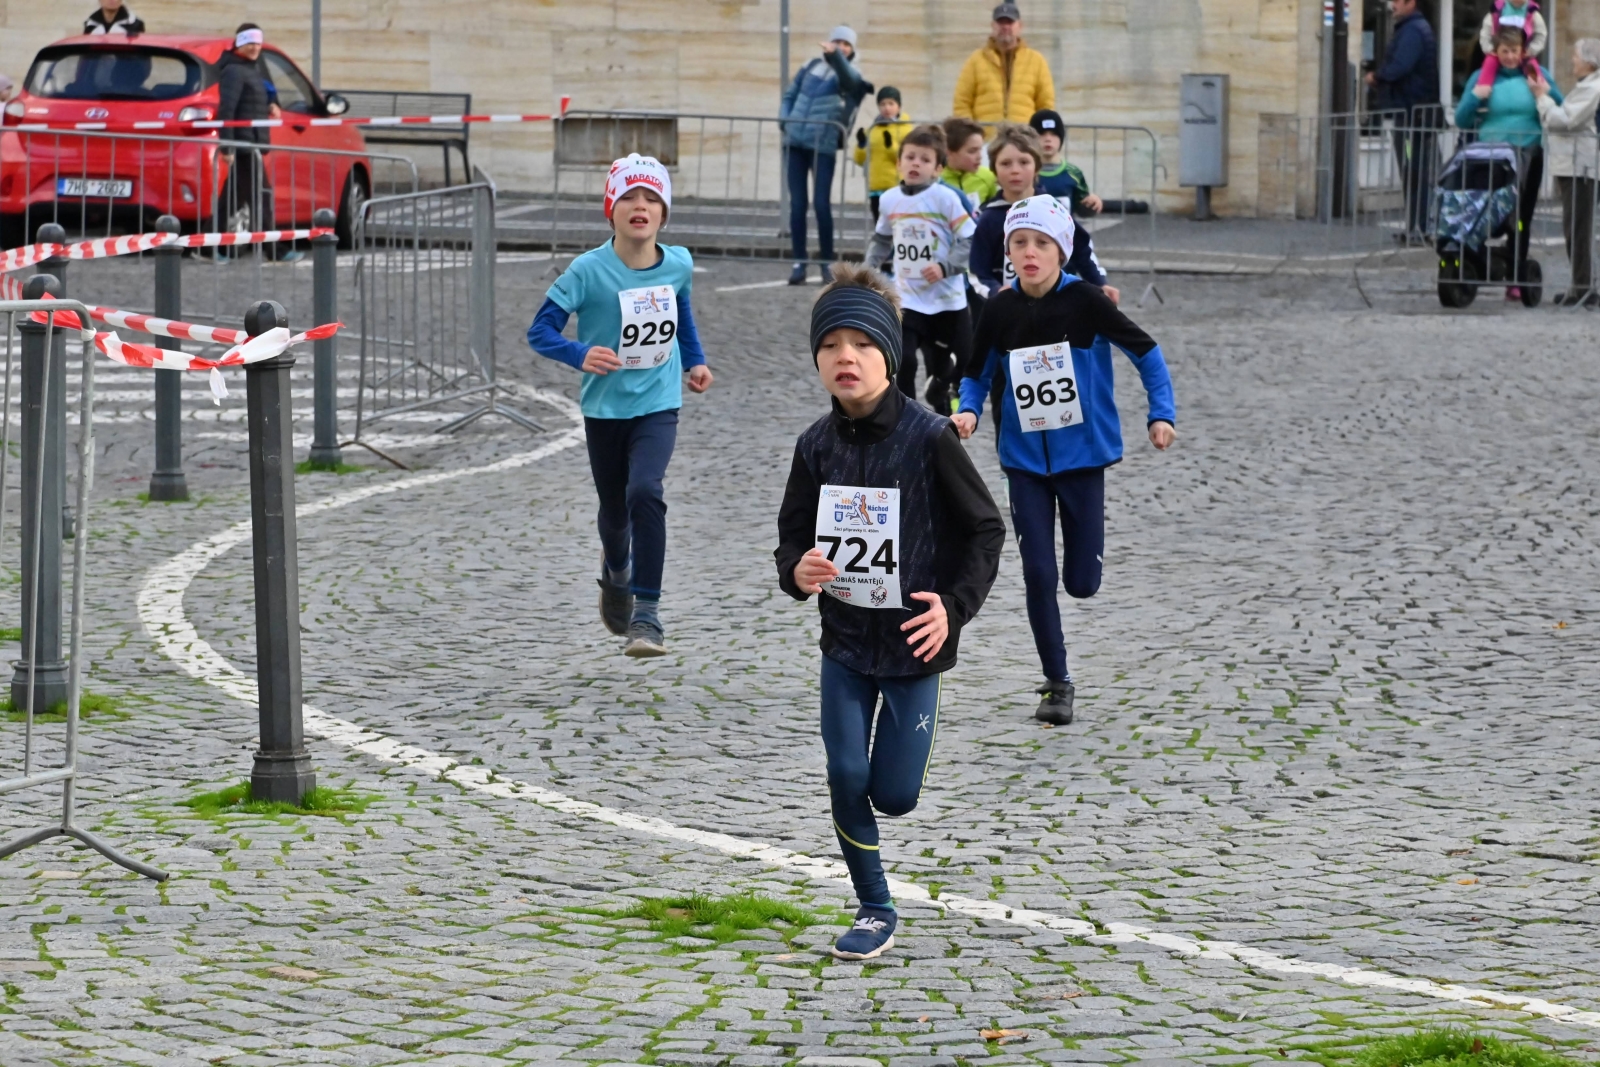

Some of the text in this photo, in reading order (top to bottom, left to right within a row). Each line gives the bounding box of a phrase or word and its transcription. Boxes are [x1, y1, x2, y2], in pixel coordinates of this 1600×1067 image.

[897, 243, 932, 262] 904
[622, 319, 676, 348] 929
[1016, 378, 1076, 410] 963
[817, 535, 897, 575] 724
[832, 590, 852, 598] CUP
